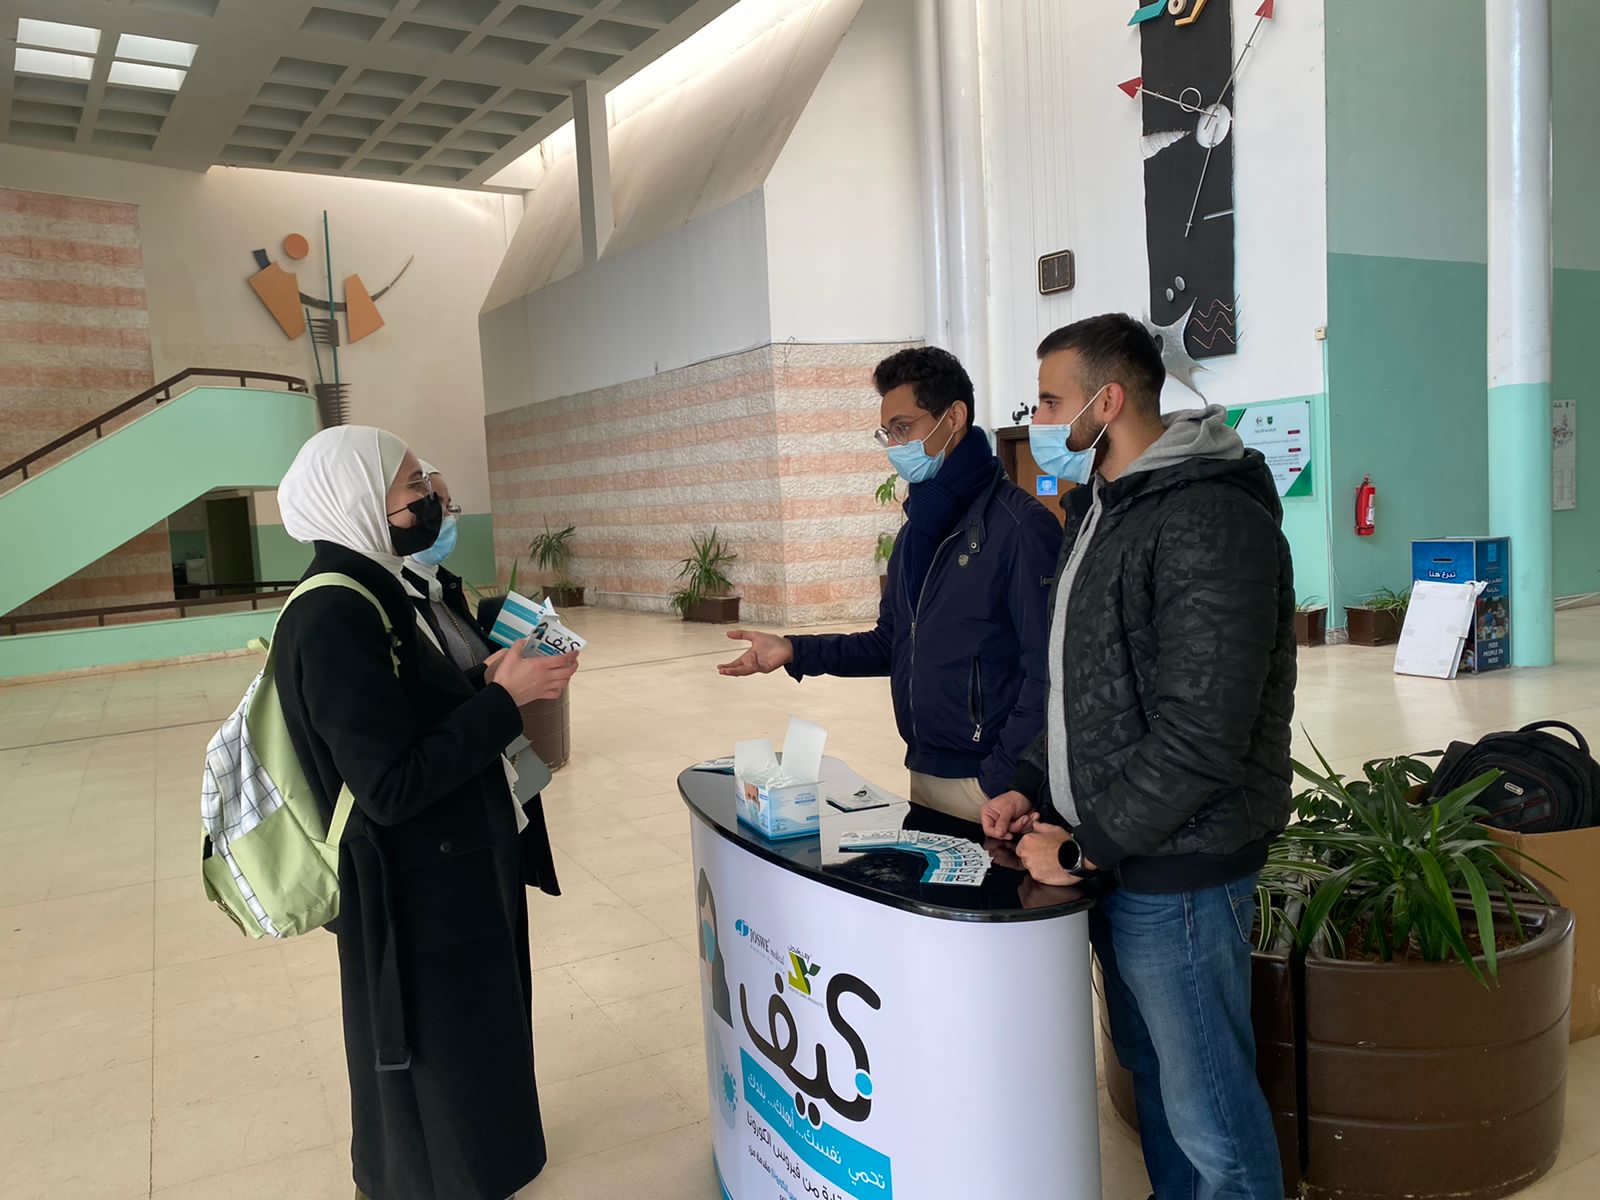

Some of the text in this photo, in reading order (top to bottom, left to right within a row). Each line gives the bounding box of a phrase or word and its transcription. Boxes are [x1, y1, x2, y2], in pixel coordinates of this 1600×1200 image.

[749, 927, 770, 953] JOSWE
[739, 972, 882, 1127] كيف
[745, 1110, 772, 1148] الكورونا
[772, 1144, 801, 1179] فيروس
[802, 1176, 820, 1199] من
[848, 1167, 886, 1190] تحمي
